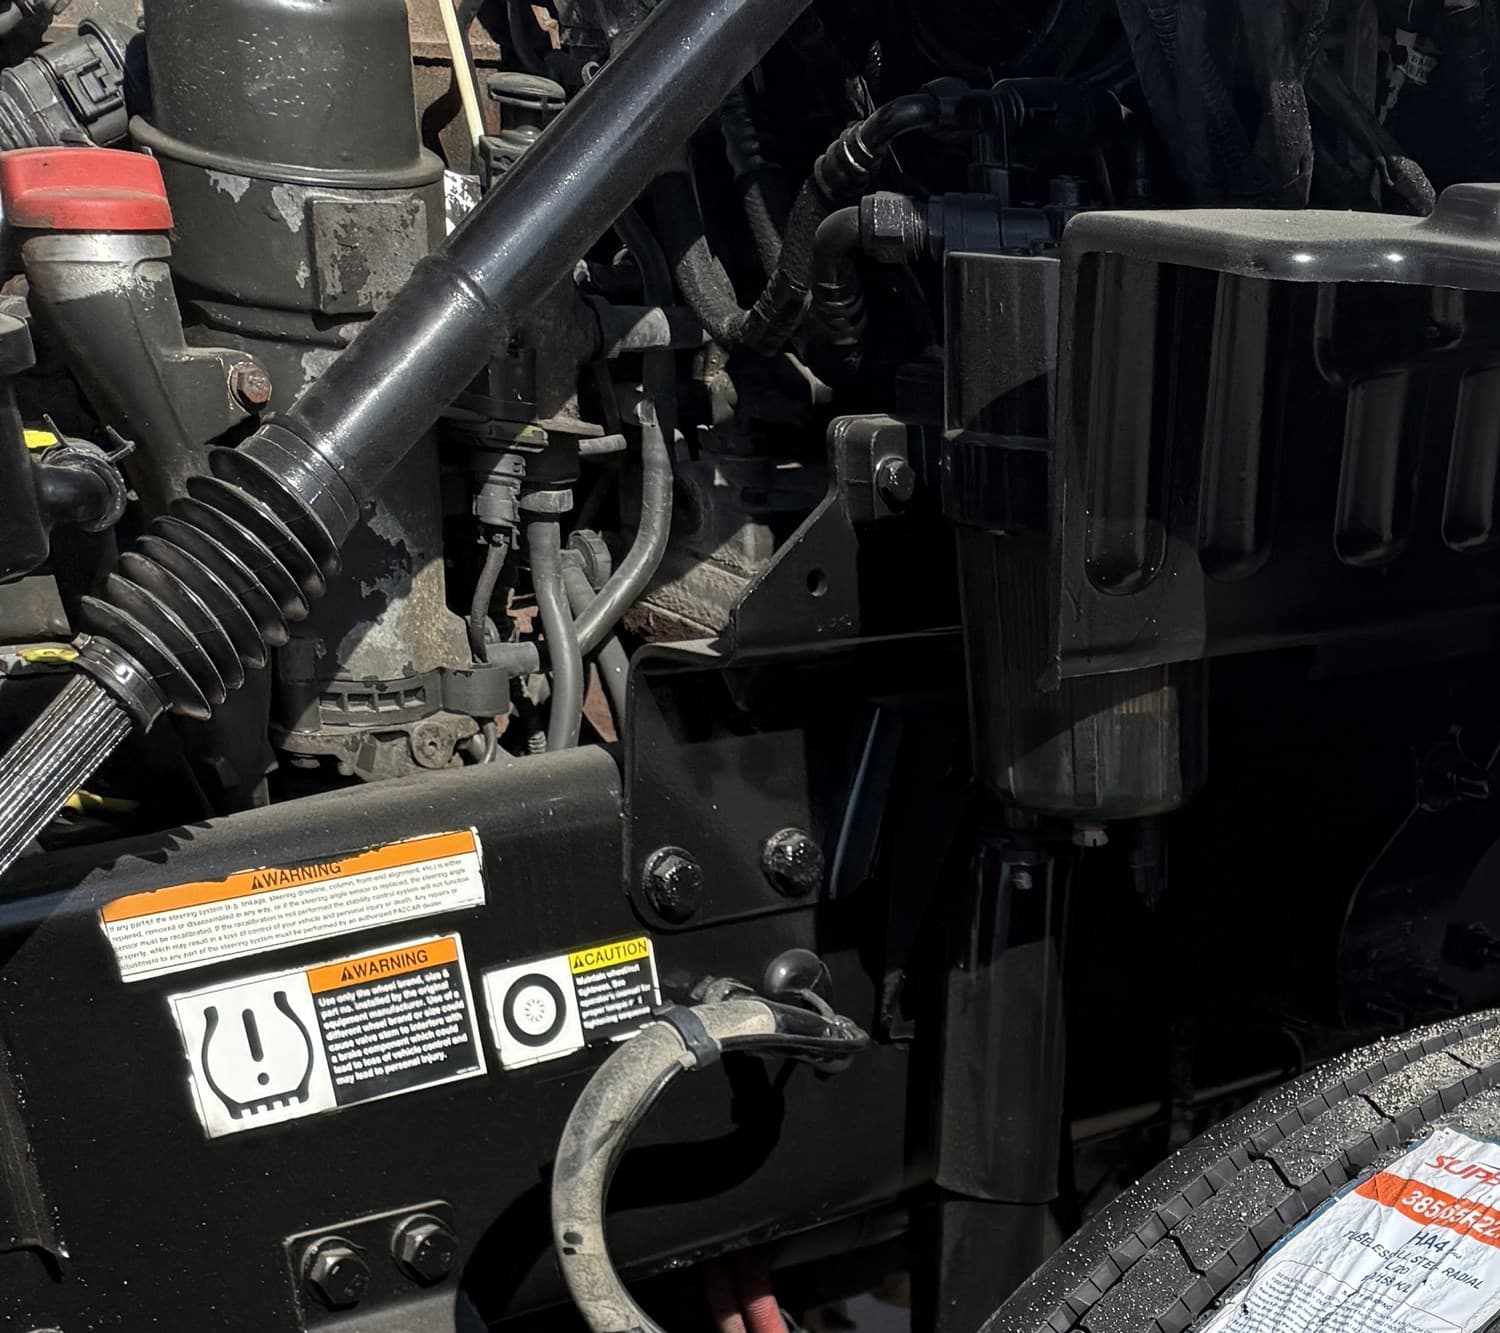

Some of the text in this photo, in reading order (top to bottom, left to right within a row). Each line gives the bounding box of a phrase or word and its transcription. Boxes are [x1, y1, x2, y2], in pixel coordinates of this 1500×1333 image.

[262, 862, 341, 887] WARNING
[353, 950, 428, 978] WARNING
[585, 941, 647, 966] CAUTION
[318, 997, 336, 1007] Use
[336, 992, 356, 1003] only
[355, 989, 371, 998] the
[371, 981, 397, 994] wheel
[320, 1007, 339, 1020] part
[339, 1005, 354, 1014] no.
[390, 992, 402, 1002] by
[402, 989, 417, 998] the
[417, 980, 449, 995] original
[323, 990, 460, 1030] equipment manufacturer. Use of a
[326, 1025, 362, 1040] different
[362, 1018, 387, 1032] wheel
[387, 1012, 413, 1026] brand
[413, 1011, 423, 1020] or
[441, 1000, 465, 1013] could
[328, 1012, 463, 1052] cause valve stem to with
[331, 1024, 459, 1063] a brake component which could
[333, 1062, 352, 1074] lead
[352, 1061, 363, 1069] to
[382, 1052, 392, 1062] of
[392, 1046, 422, 1059] vehicle
[422, 1037, 452, 1051] control
[452, 1033, 468, 1044] and
[336, 1074, 354, 1085] may
[354, 1068, 374, 1080] lead
[374, 1067, 384, 1076] to
[384, 1056, 420, 1074] personal
[1408, 1231, 1451, 1252] HA4
[1441, 1267, 1483, 1289] RADIAL
